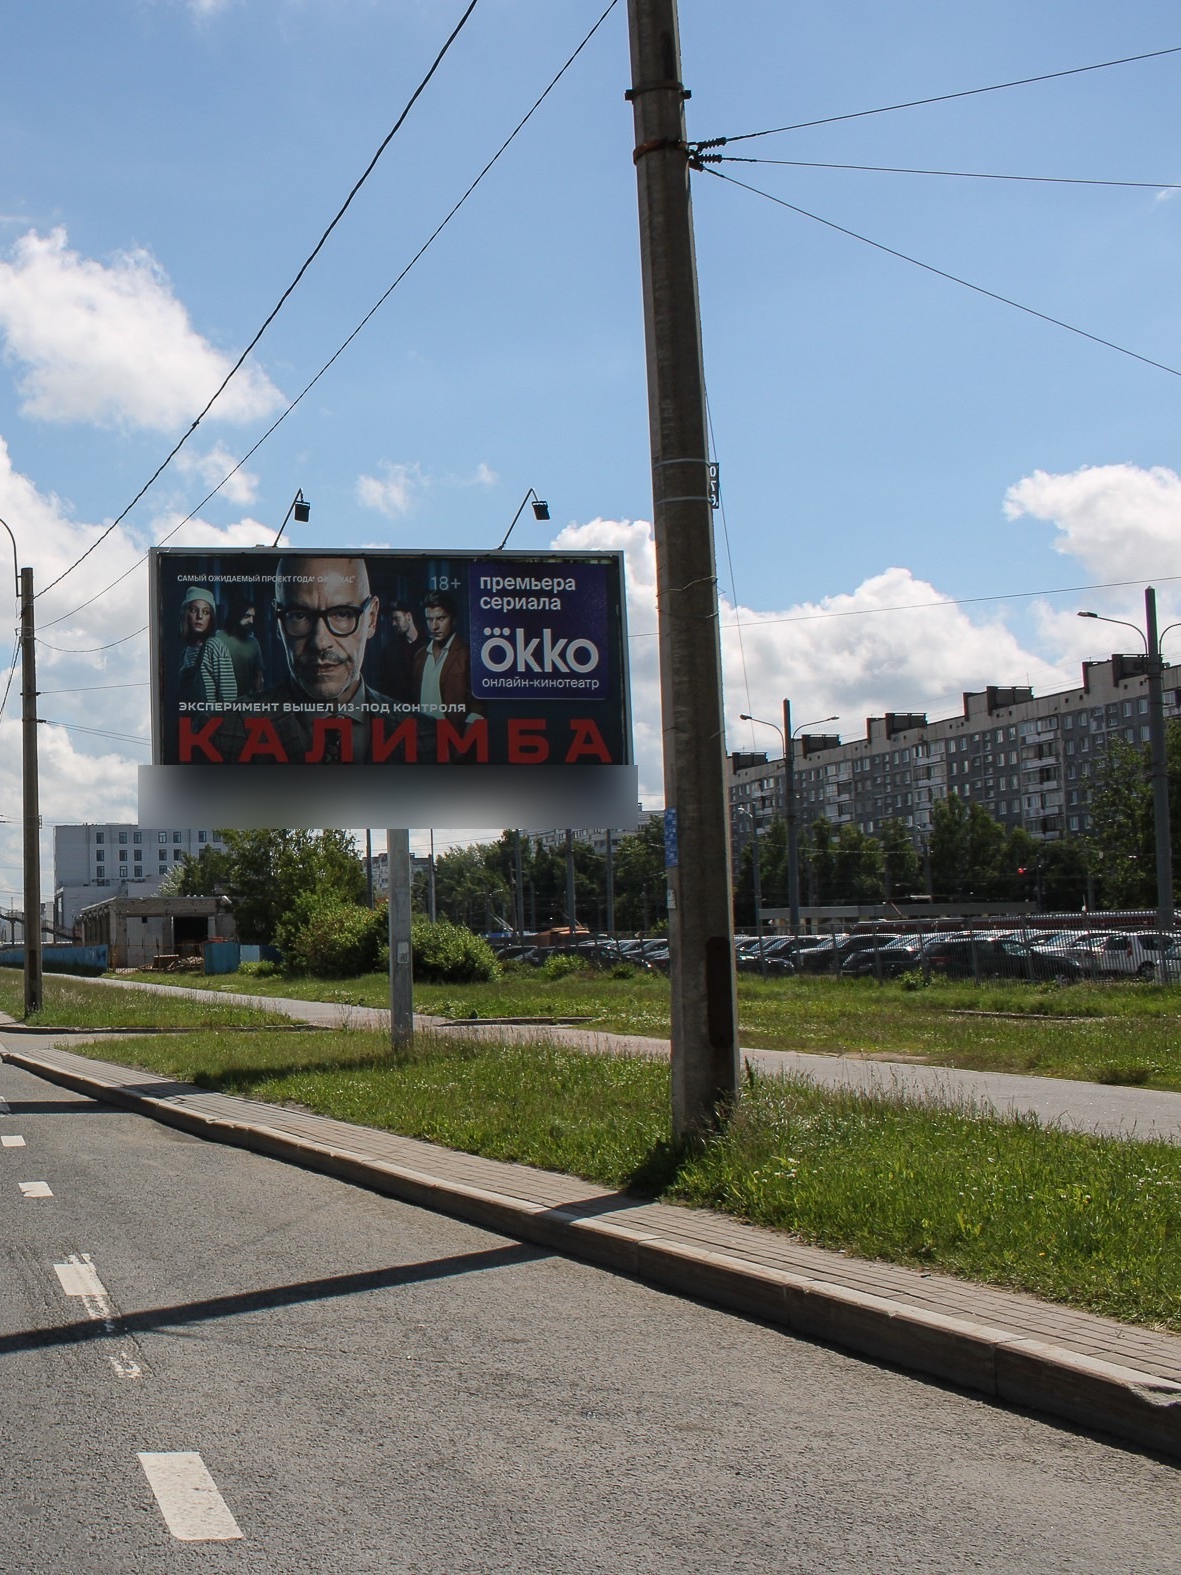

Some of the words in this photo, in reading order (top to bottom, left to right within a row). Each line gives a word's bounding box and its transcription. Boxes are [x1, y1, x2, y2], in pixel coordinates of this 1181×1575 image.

[177, 574, 207, 582] САМЫЙ
[208, 574, 260, 583] ОЖИДАЕМЫЙ
[262, 575, 292, 583] ПРОЕКТ
[430, 576, 461, 591] 18+
[480, 576, 576, 594] премьера
[480, 596, 562, 613] сериала
[482, 676, 600, 690] онлайн-кинотеатр
[178, 702, 280, 712] ЭКСПЕРИМЕНТ
[283, 702, 334, 712] ВЫШЕЛ
[337, 703, 390, 714] ИЗ-ПОД
[393, 703, 467, 713] КОНТРОЛЯ
[178, 717, 613, 764] КАЛИМБА
